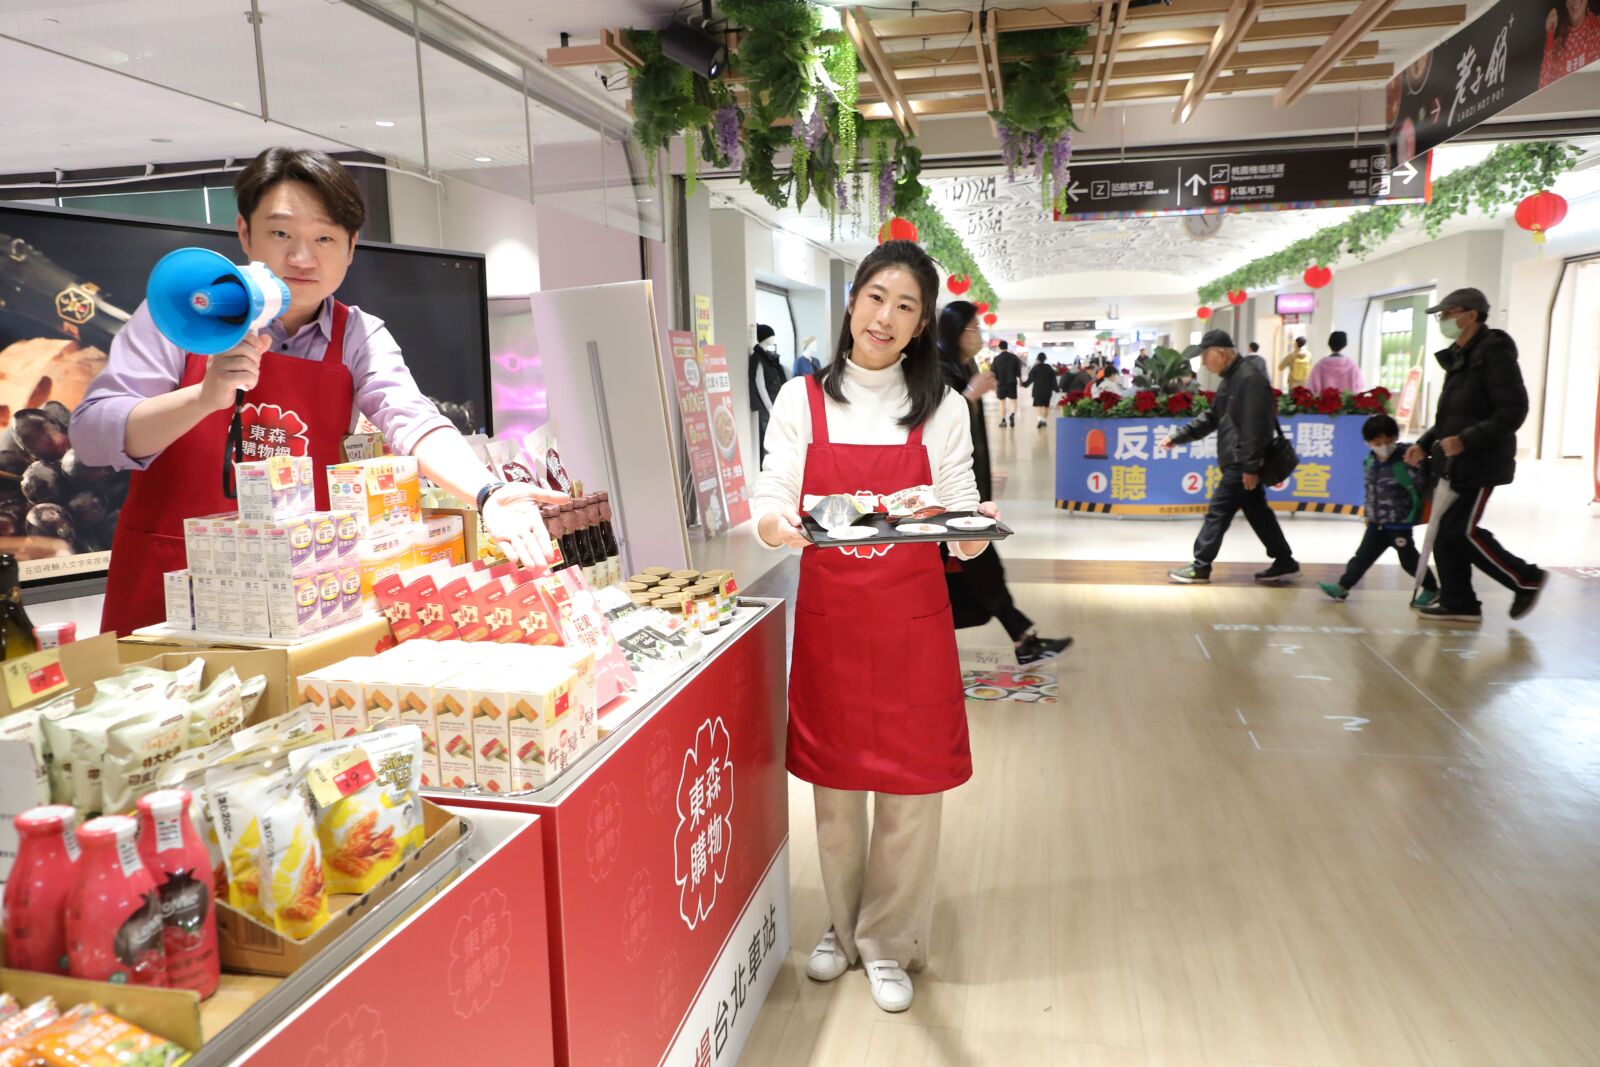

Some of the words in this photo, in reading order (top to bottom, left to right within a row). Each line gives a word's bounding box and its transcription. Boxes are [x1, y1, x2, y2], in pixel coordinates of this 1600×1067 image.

[1477, 97, 1490, 113] HOT
[1491, 88, 1505, 103] POT
[241, 440, 291, 458] 購物網
[249, 424, 287, 443] 東森
[1110, 464, 1147, 500] 聽
[1292, 463, 1332, 498] 查
[689, 756, 721, 832] 東森
[690, 813, 722, 893] 購物
[714, 903, 776, 1061] 台北車站
